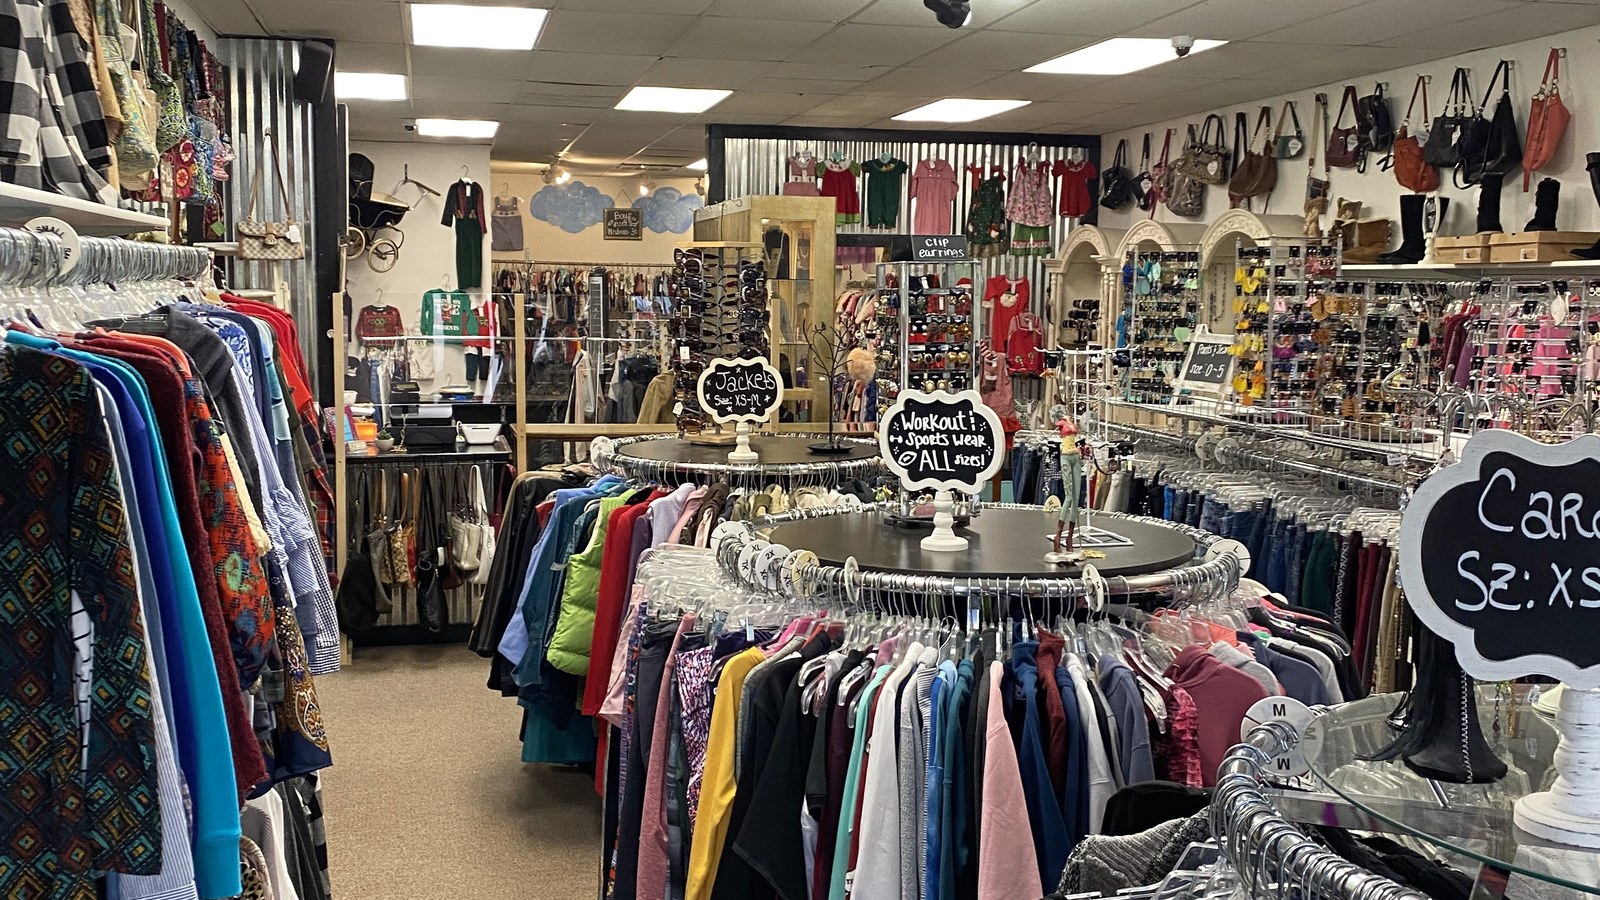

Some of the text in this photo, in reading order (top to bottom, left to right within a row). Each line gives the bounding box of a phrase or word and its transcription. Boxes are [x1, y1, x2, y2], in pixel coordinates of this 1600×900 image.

[918, 248, 965, 258] earrings
[715, 370, 776, 393] Jackets
[735, 394, 761, 406] XS-M
[919, 449, 985, 472] ALL sizes!
[751, 544, 762, 552] XL
[765, 550, 775, 560] 2X
[1455, 550, 1535, 612] Sz:
[1273, 704, 1286, 717] M
[1277, 758, 1290, 770] M
